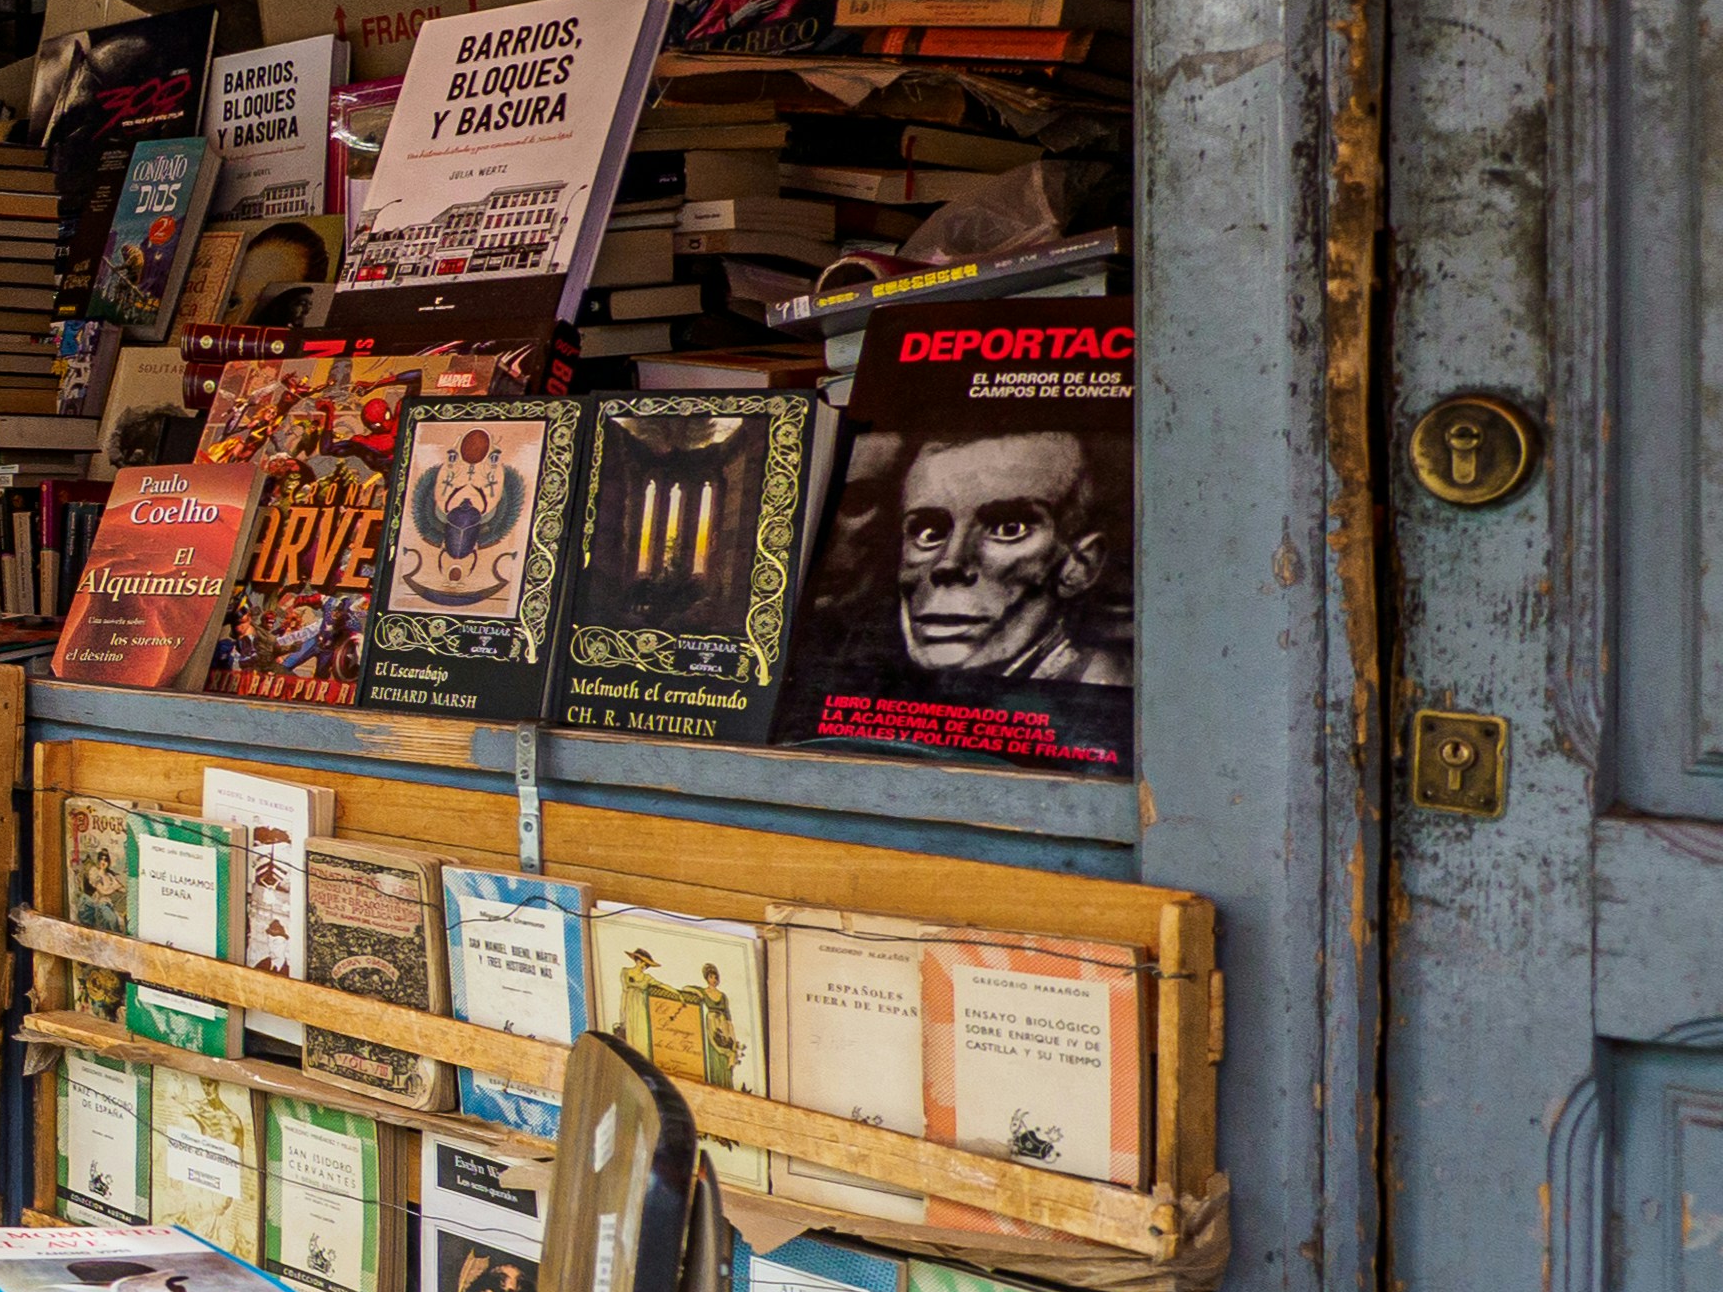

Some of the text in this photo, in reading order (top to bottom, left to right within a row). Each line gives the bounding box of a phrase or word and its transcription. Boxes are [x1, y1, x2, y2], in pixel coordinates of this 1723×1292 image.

[456, 17, 582, 65] BARRIOS,
[223, 60, 299, 95] BARRIOS,
[446, 54, 574, 101] BLOQUES
[222, 88, 296, 122] BLOQUES
[431, 93, 567, 140] Y BASURA
[216, 116, 299, 150] Y BASURA
[132, 154, 188, 182] CONTRATO
[135, 182, 182, 213] DIOS
[437, 373, 475, 388] MARVEL
[968, 385, 1037, 398] CAMPOS
[1038, 385, 1061, 398] DE
[972, 372, 1122, 384] EL HORROR DE LOS
[139, 474, 190, 494] Paulo
[129, 497, 218, 525] Coelho
[173, 547, 194, 566] El
[76, 568, 224, 602] Alquimista
[460, 624, 512, 638] VALDEMAR
[65, 649, 125, 663] el destino
[677, 638, 739, 655] VALDEMAR
[374, 661, 449, 687] El Escarabajo
[370, 686, 478, 709] RICHARD MARSH
[569, 677, 748, 710] Melmoth el errabundo
[566, 705, 718, 738] CH. R. MATURIN
[824, 694, 1051, 726] LIBRO RECOMENDADO POR
[821, 709, 1057, 742] LA ACADEMIA DE CIENCIAS
[817, 721, 895, 742] MORALES
[899, 728, 910, 741] Y
[1006, 737, 1033, 755] DE
[1035, 741, 1119, 764] FRANCIA
[149, 869, 167, 882] QUÉ
[169, 873, 215, 891] LLAMAMOS
[161, 886, 193, 902] ESPAÑA
[825, 980, 905, 1003] ESPAÑOLES
[971, 974, 1029, 992] GREGORIO
[805, 993, 919, 1018] FUERA DE ESPAÑ
[964, 1007, 1102, 1036] ENSAYO BIOLÓGICO
[964, 1023, 1102, 1052] SOBRE ENRIQUE IV DE
[964, 1039, 1103, 1070] CASTILLA Y SU TIEMPO
[288, 1145, 307, 1160] SAN
[288, 1160, 357, 1190] CERVANTES
[6, 1226, 174, 1242] MOMENTO
[50, 1238, 109, 1250] AVE
